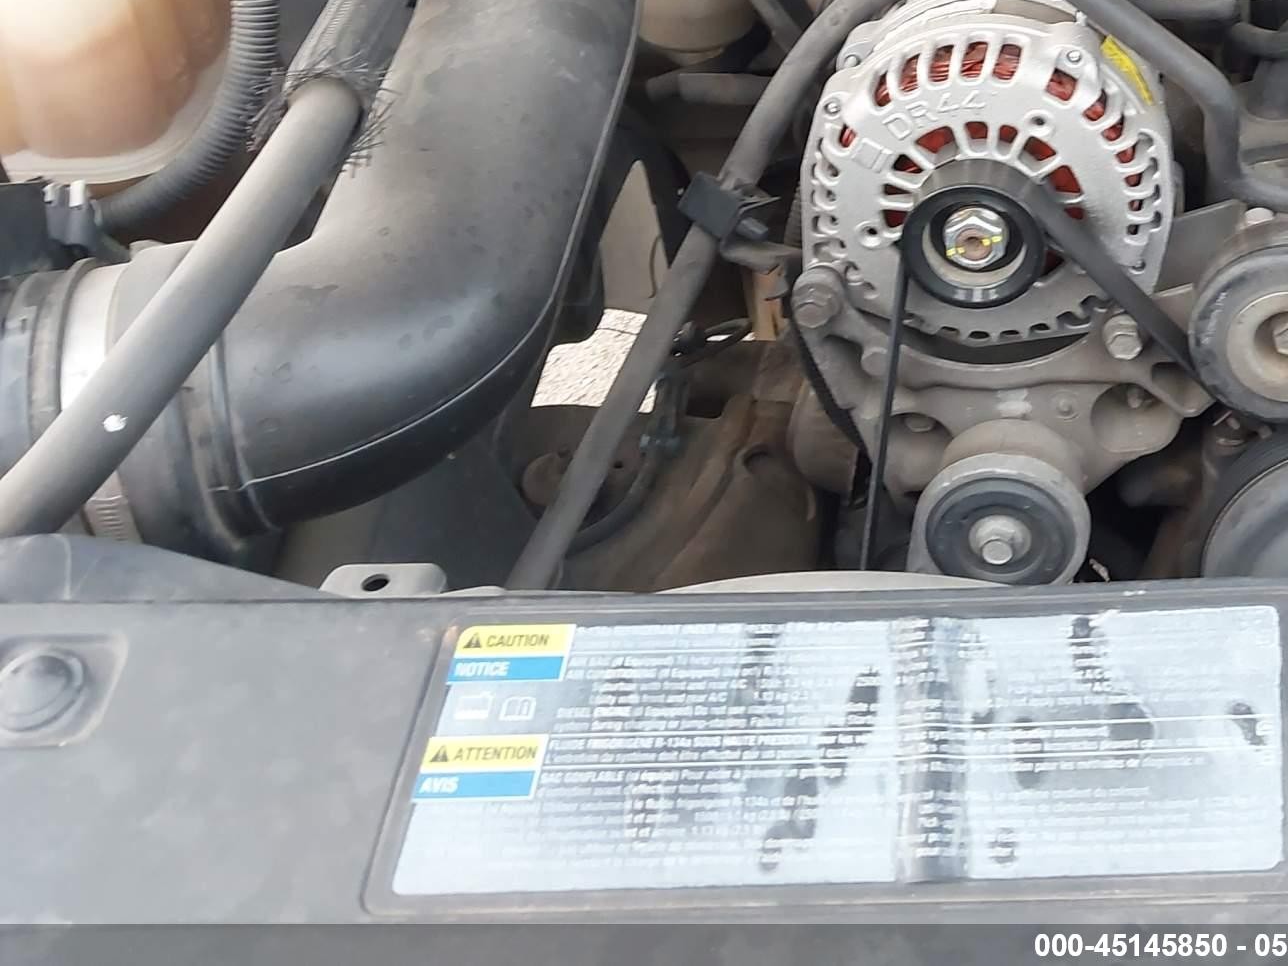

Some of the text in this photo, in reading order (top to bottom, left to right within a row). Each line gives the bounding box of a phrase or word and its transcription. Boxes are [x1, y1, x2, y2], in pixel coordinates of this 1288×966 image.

[486, 634, 550, 647] CAUTION
[453, 661, 511, 677] NOTICE
[454, 746, 538, 761] ATTENTION
[419, 776, 461, 794] AVIS
